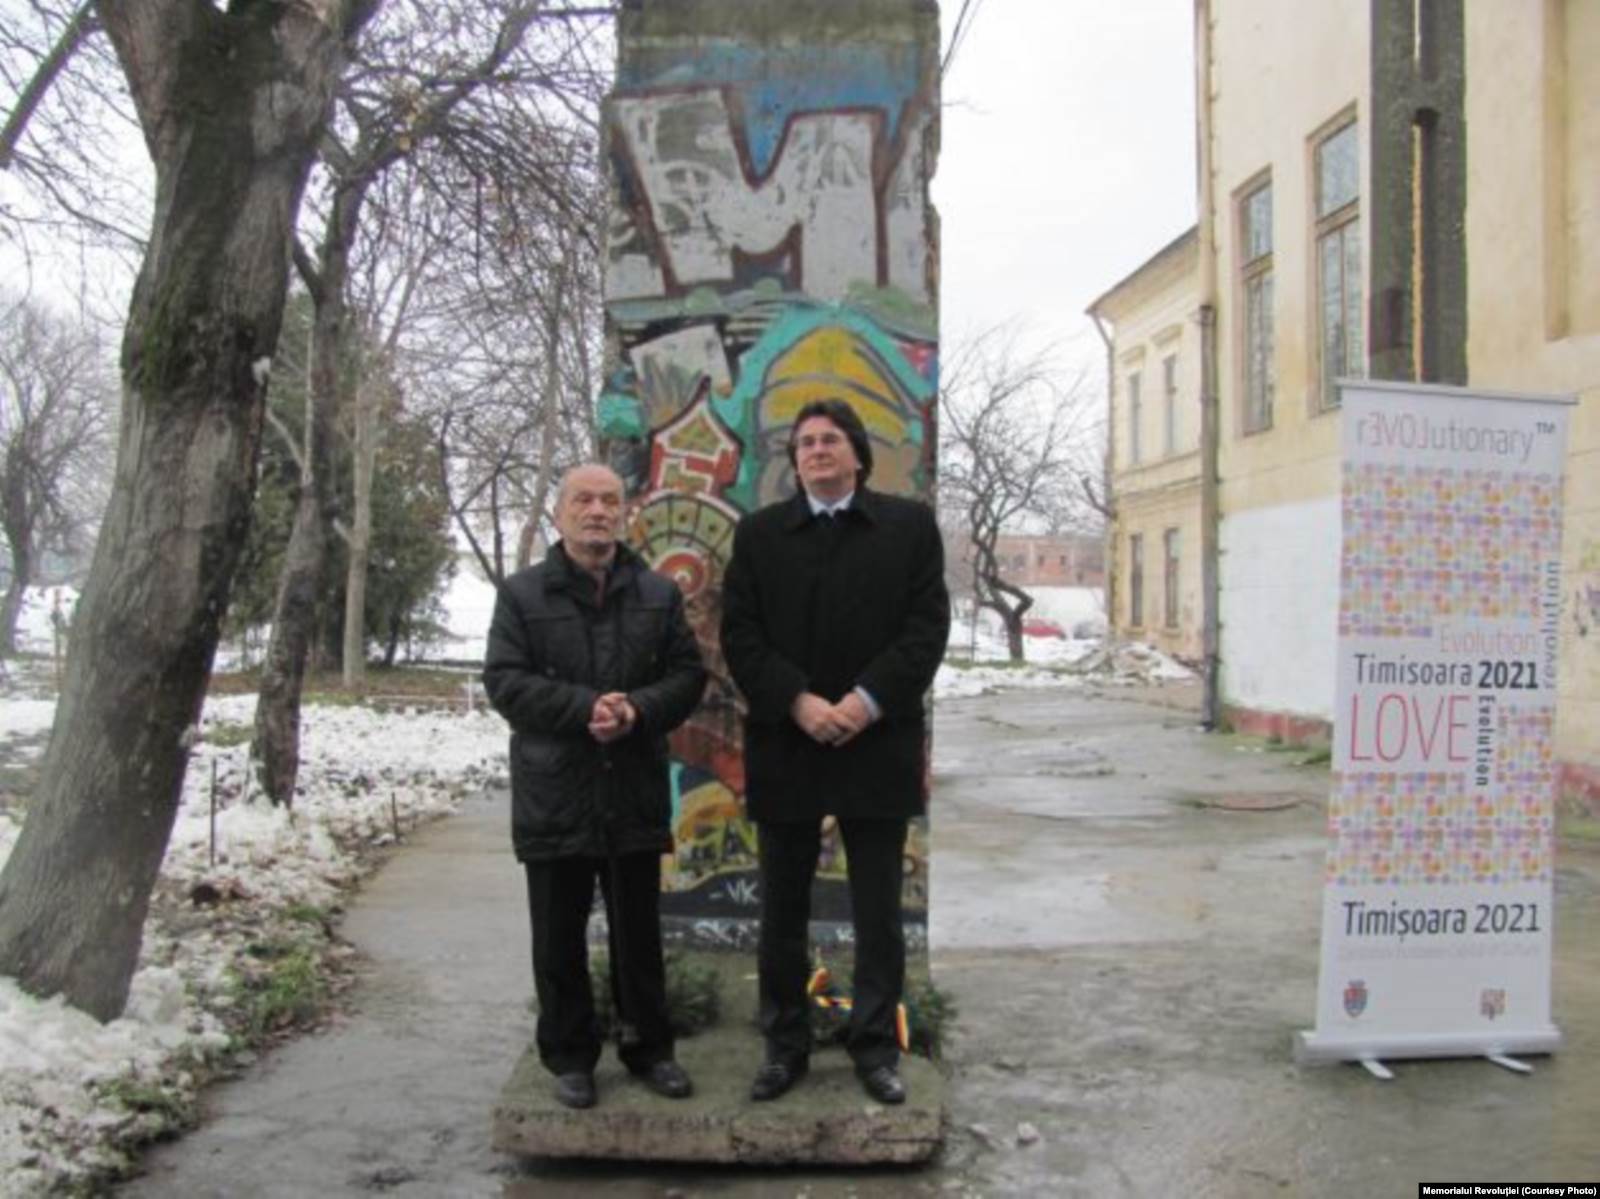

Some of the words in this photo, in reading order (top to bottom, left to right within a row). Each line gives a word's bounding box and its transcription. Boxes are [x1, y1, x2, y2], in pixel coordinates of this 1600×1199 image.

[1440, 624, 1536, 653] Evolution
[1355, 654, 1473, 686] Timisoara
[1478, 660, 1539, 690] 2021
[1350, 693, 1471, 763] LOVE
[1475, 694, 1497, 787] Evolution
[1474, 904, 1541, 934] 2021
